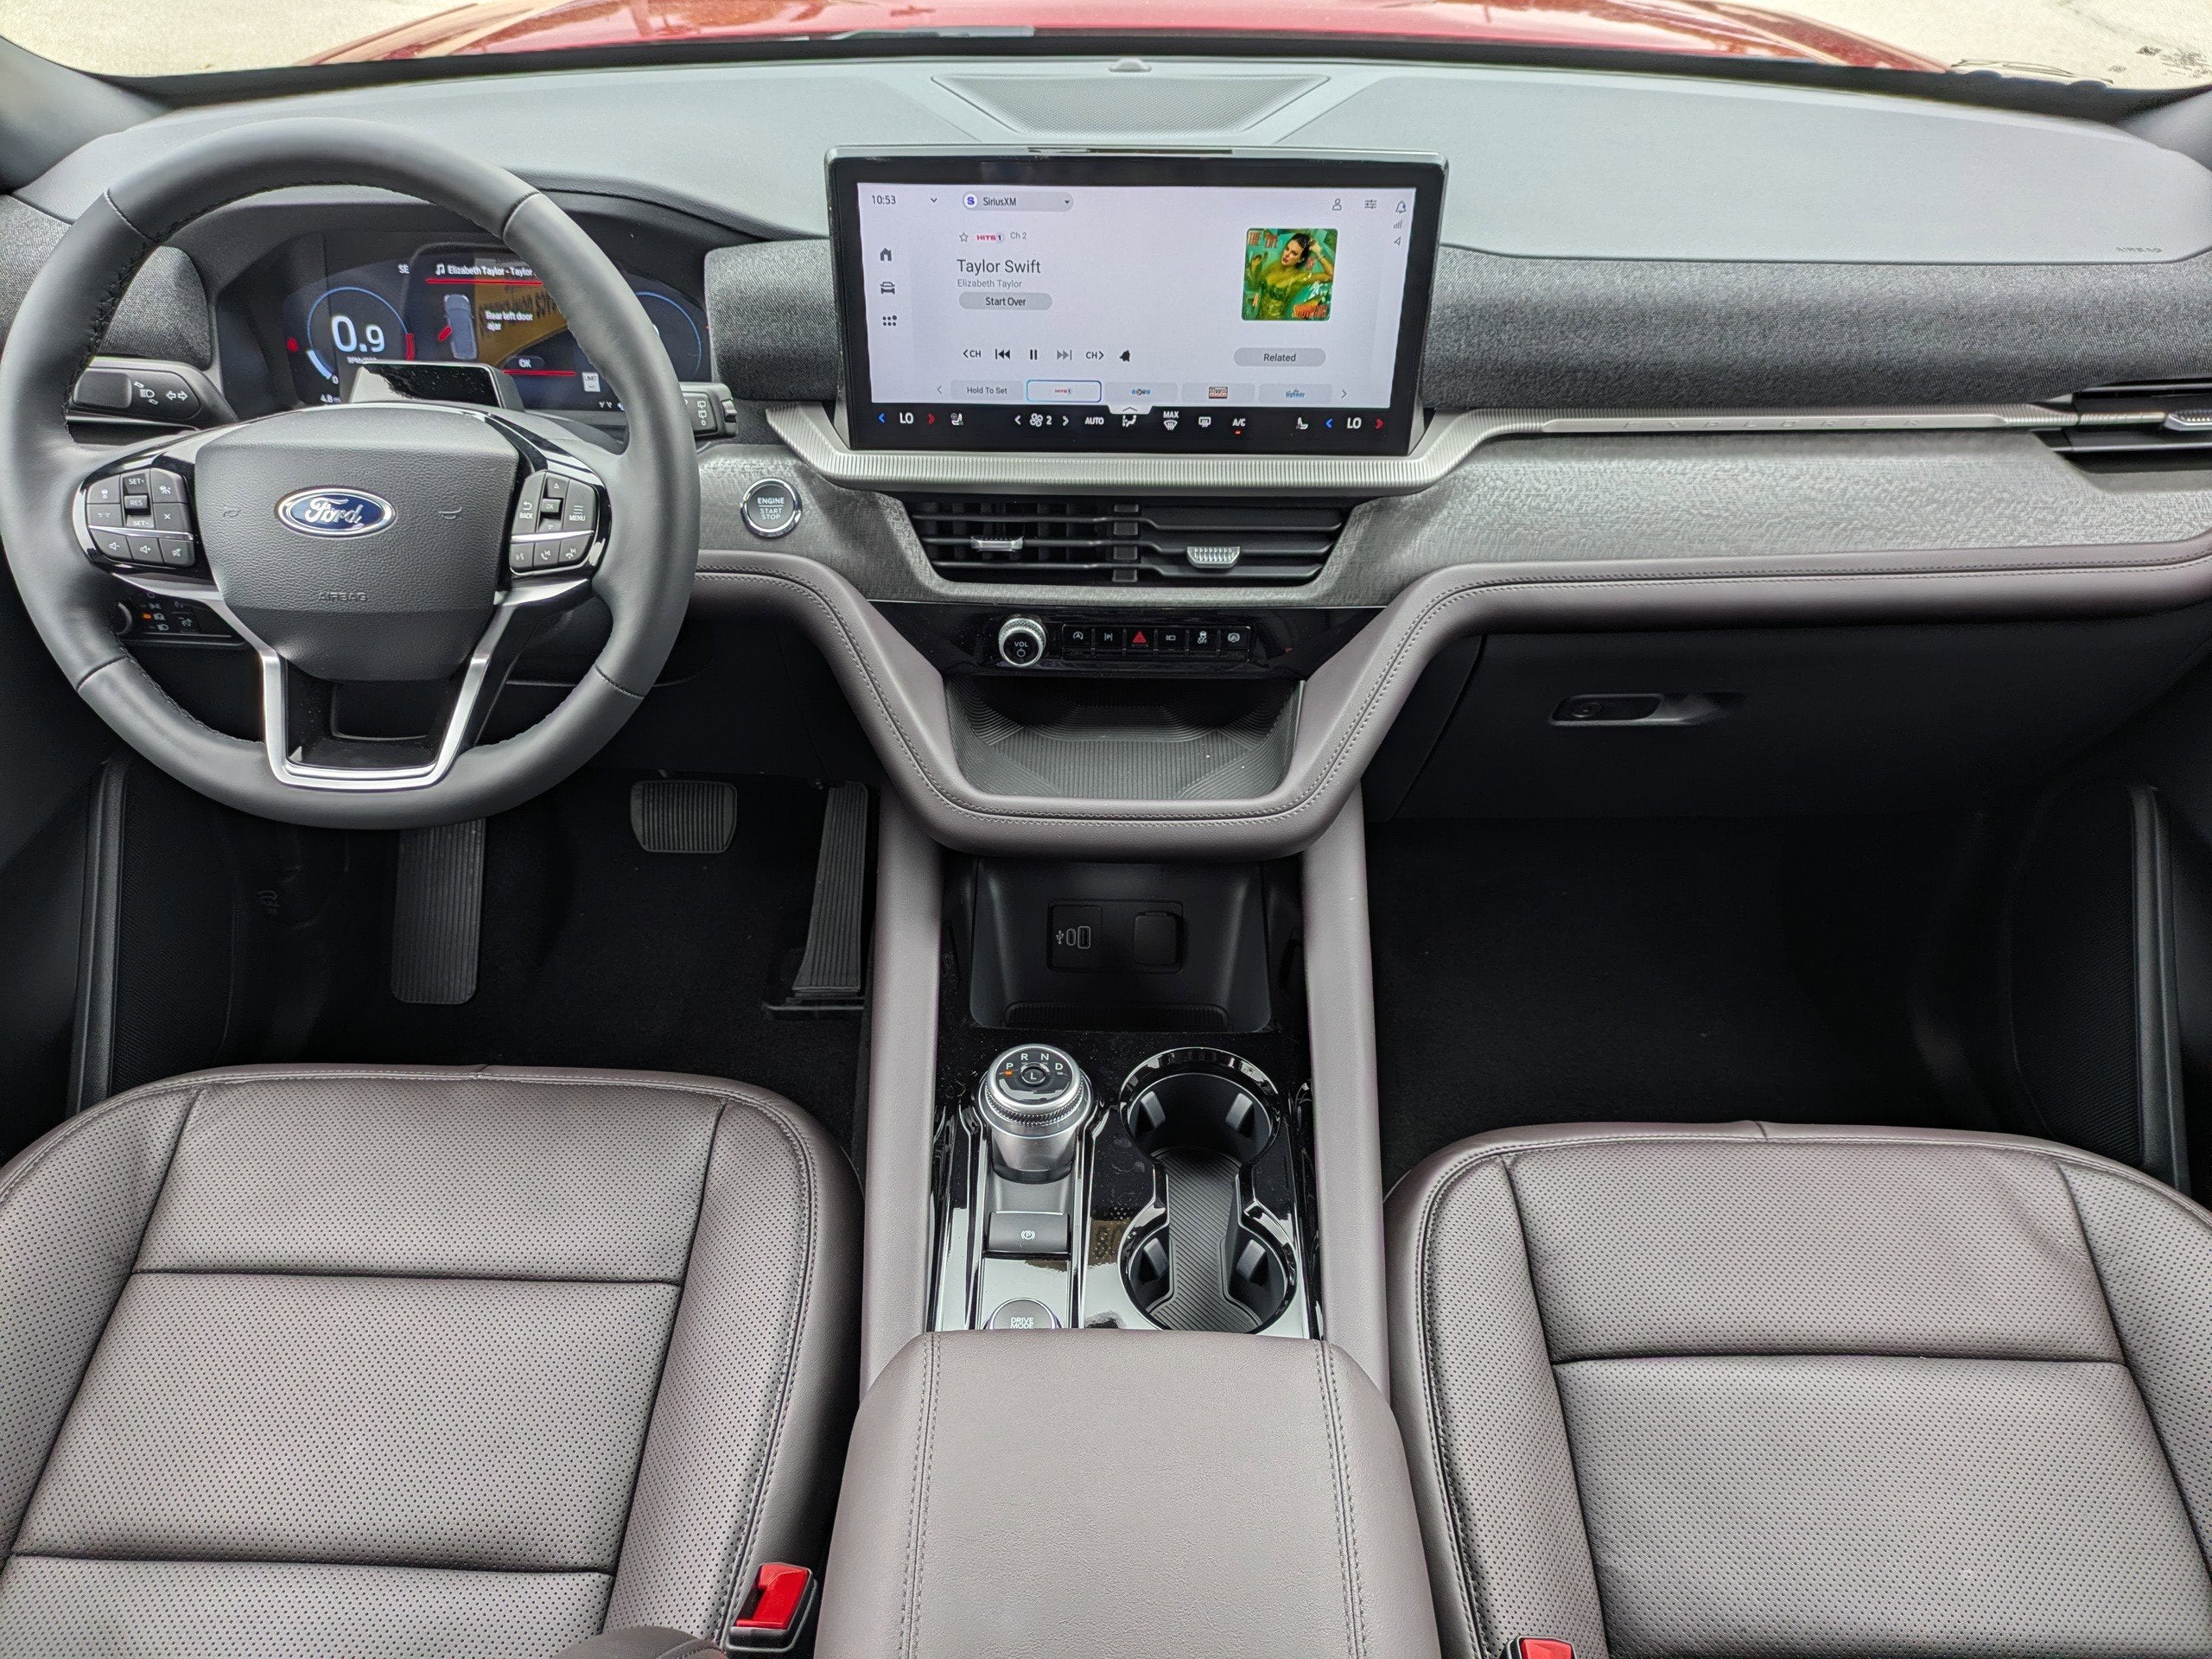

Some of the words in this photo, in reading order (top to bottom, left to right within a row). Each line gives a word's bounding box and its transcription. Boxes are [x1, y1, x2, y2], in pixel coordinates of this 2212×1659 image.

[872, 195, 896, 205] 10:53
[982, 197, 1017, 207] SiriusXM
[398, 264, 410, 274] SE
[448, 265, 481, 275] Elizabeth
[481, 266, 505, 276] Taylor
[510, 267, 532, 276] Taylor
[957, 259, 1001, 276] Taylor
[1005, 259, 1041, 273] Swift
[957, 278, 995, 289] Elizabeth
[997, 279, 1022, 289] Taylor
[985, 296, 1005, 306] Start
[1007, 296, 1027, 307] Over
[486, 310, 502, 321] Rear
[503, 310, 516, 321] left
[516, 312, 533, 321] door
[331, 315, 385, 353] 0.9
[1263, 353, 1296, 362] Related
[518, 358, 531, 368] OK
[967, 386, 982, 395] Hold
[984, 386, 994, 395] To
[996, 386, 1007, 395] Set
[899, 413, 914, 424] LO
[1046, 416, 1052, 424] 2
[1084, 416, 1104, 425] AUTO
[1232, 418, 1246, 427] A/C
[1346, 417, 1362, 429] LO
[304, 497, 364, 524] Ford
[319, 592, 368, 601] AIRBAG
